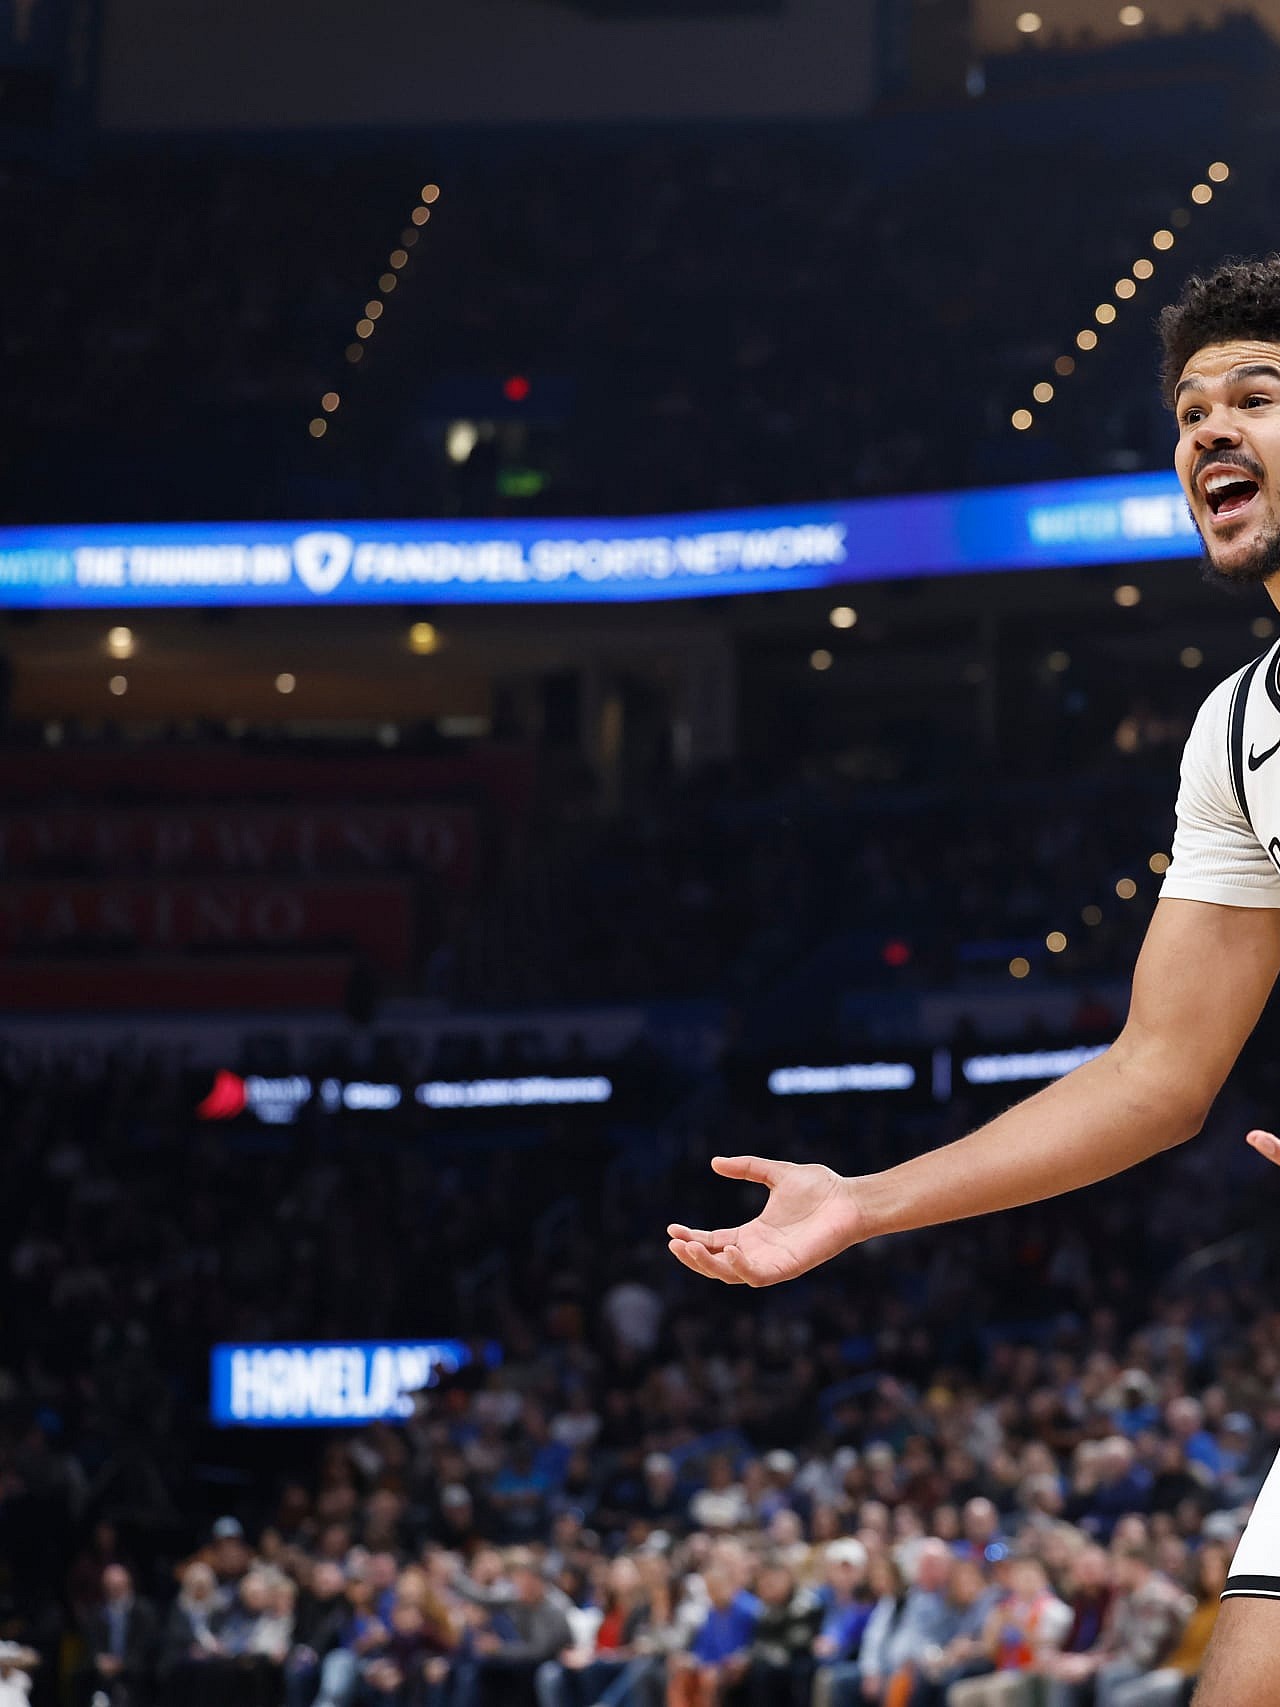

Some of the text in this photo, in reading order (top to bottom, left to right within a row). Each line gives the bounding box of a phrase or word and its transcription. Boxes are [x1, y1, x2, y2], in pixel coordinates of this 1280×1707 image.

[353, 540, 530, 584] FANDUEL
[530, 536, 675, 583] SPORTS
[673, 522, 848, 575] NETWORK
